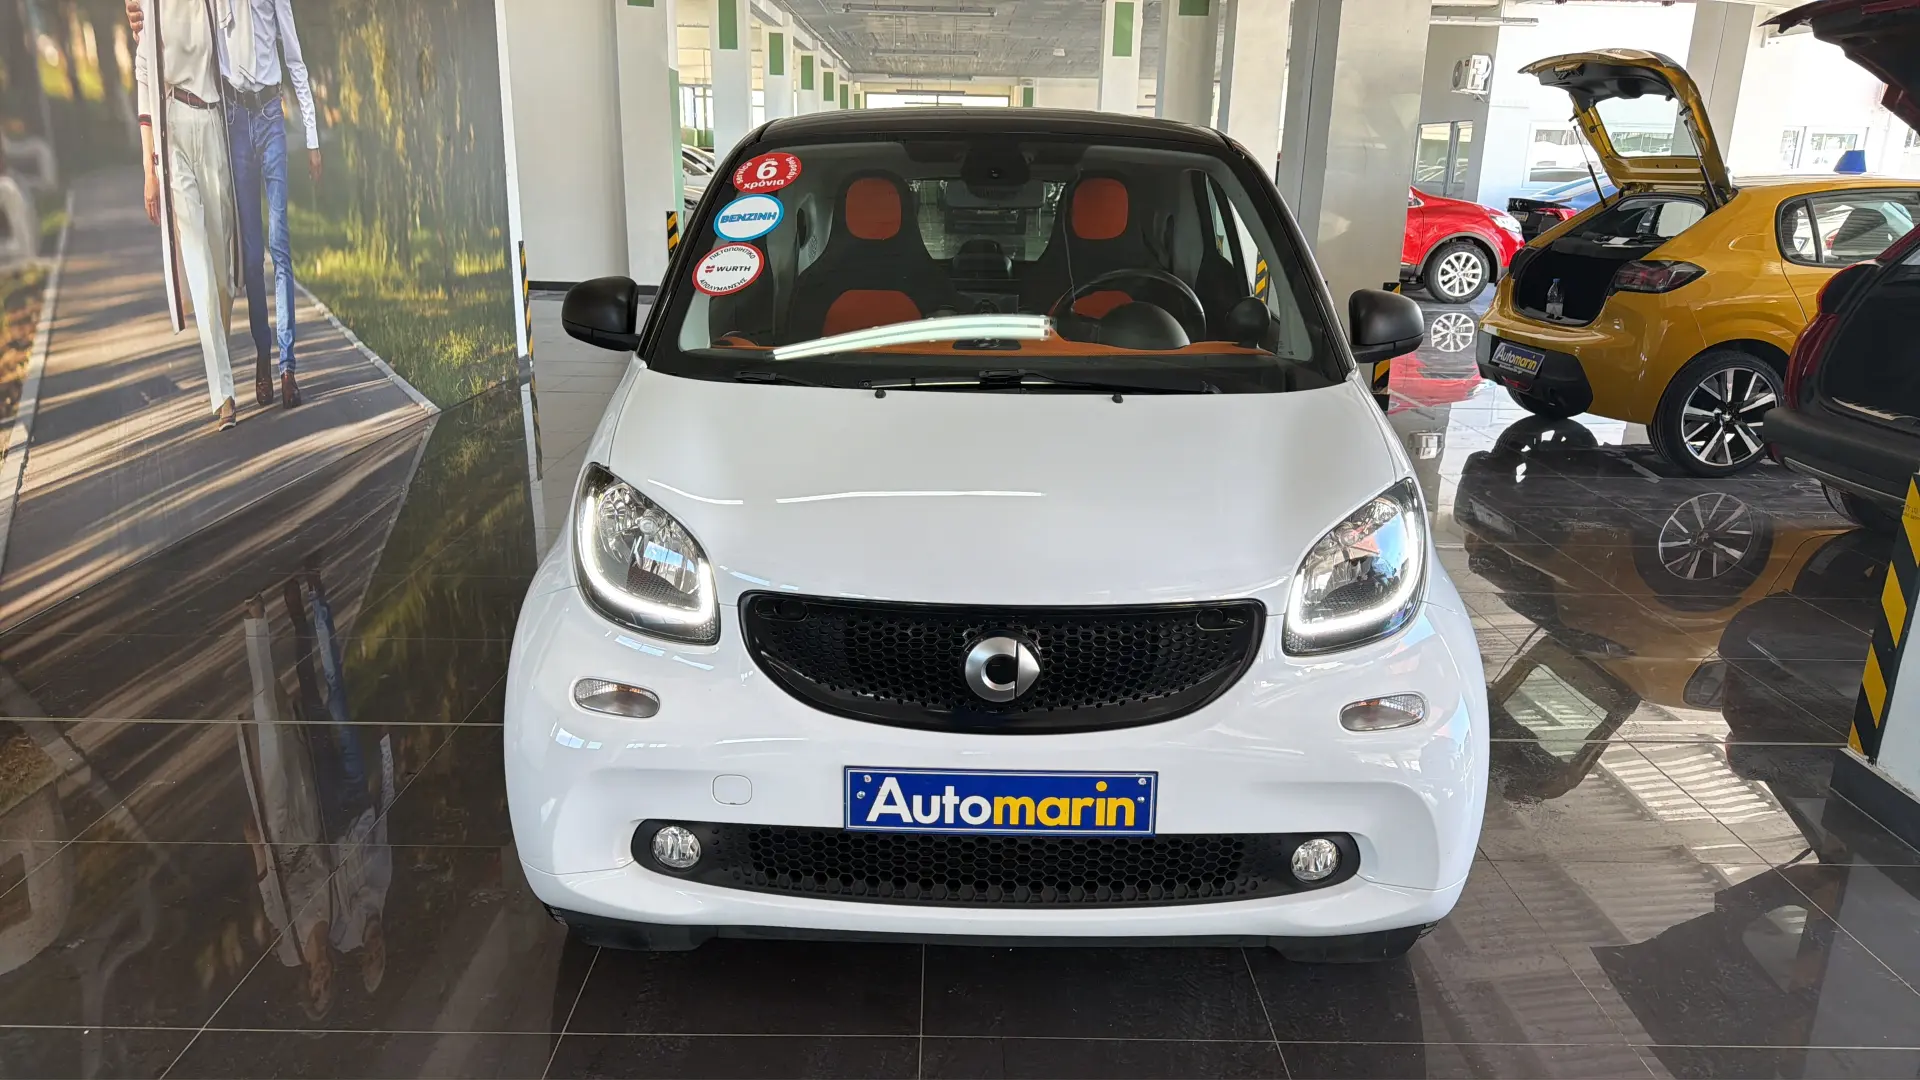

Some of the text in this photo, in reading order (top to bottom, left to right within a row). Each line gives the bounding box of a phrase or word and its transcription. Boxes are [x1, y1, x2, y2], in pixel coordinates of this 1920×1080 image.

[756, 160, 779, 180] 6
[742, 179, 785, 190] χρόνια
[720, 211, 778, 224] ΒΕΝΖΙΝΗ
[1495, 345, 1538, 371] Automarin
[865, 776, 1136, 827] Automarin
